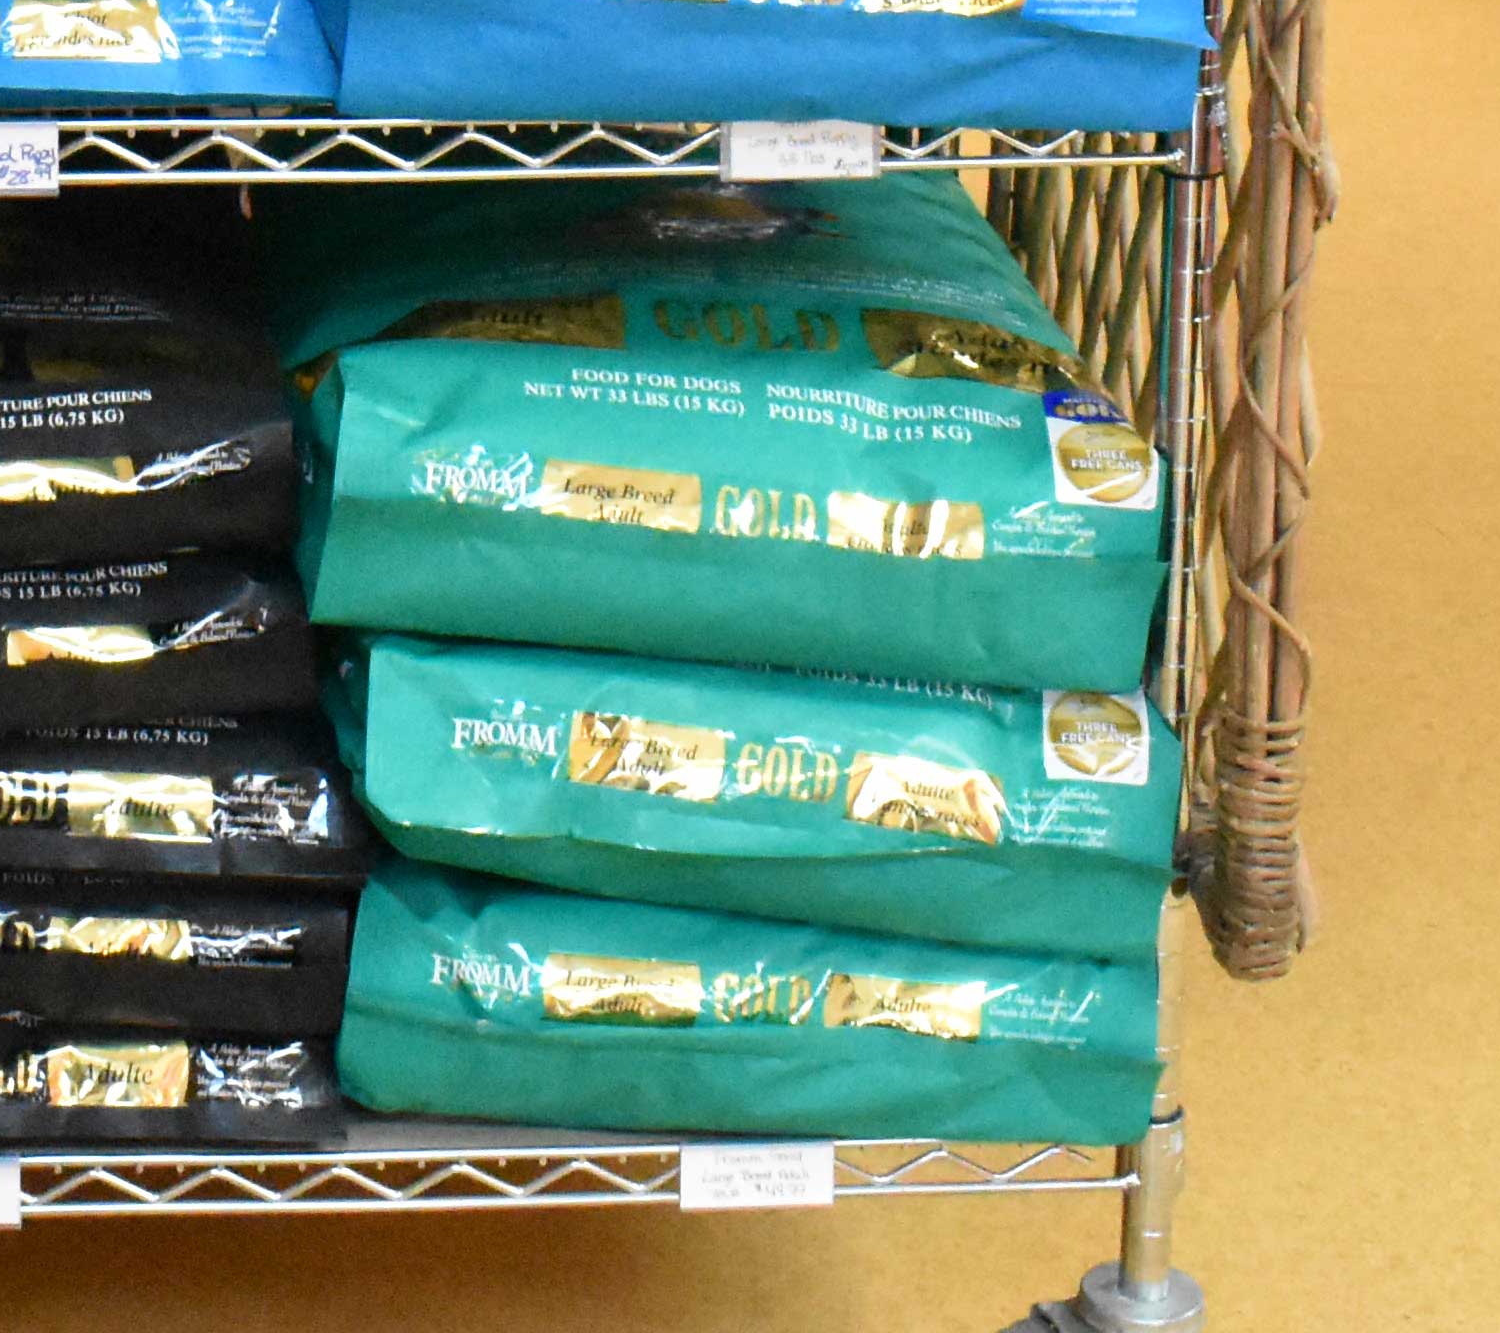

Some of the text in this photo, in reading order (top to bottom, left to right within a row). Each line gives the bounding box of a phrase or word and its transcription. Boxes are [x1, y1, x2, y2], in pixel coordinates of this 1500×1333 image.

[46, 392, 90, 409] POUR
[91, 389, 153, 406] CHIENS
[1084, 447, 1128, 464] THREE
[1069, 456, 1145, 474] FREE CANS
[1076, 720, 1117, 735] THREE
[1060, 731, 1133, 747] FREE CANS
